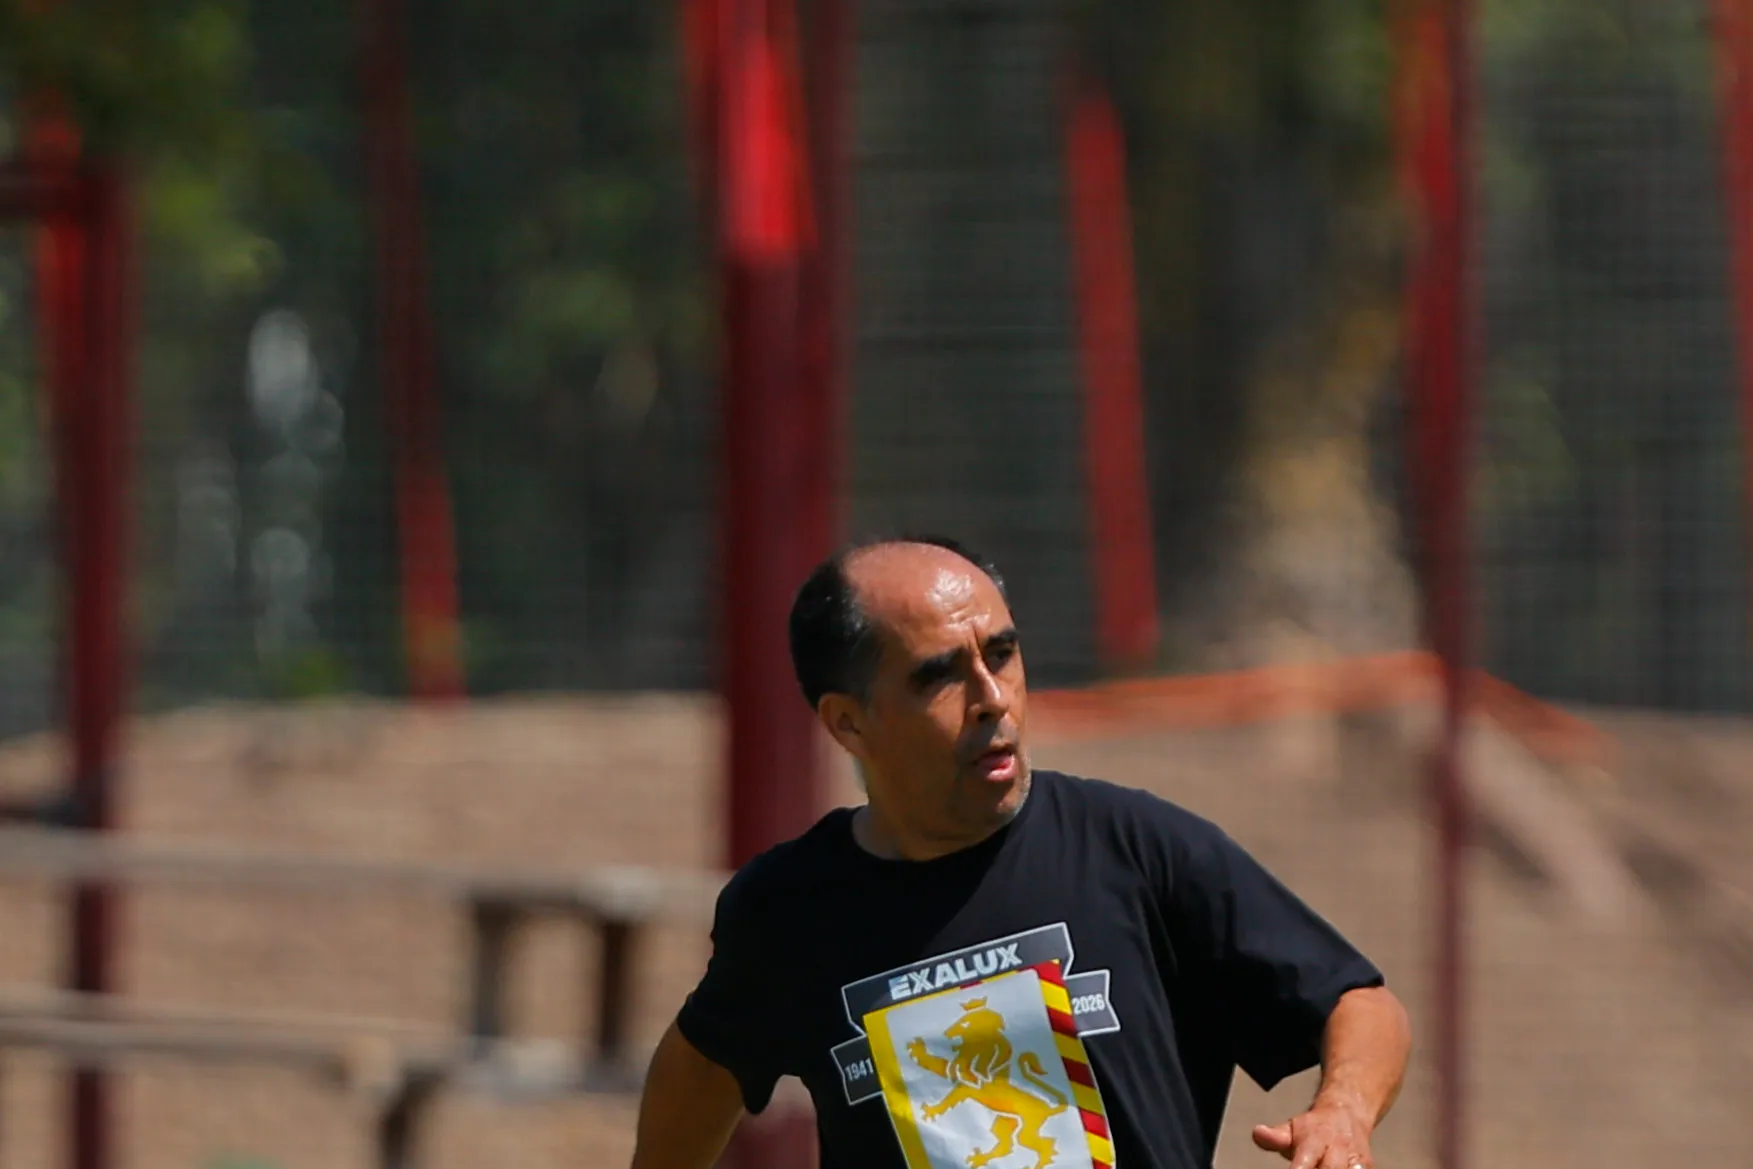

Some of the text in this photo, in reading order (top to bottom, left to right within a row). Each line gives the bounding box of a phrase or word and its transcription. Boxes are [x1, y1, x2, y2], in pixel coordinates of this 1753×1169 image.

[888, 943, 1022, 1000] EXALUX
[1071, 993, 1105, 1015] 2026
[845, 1057, 874, 1081] 1941
